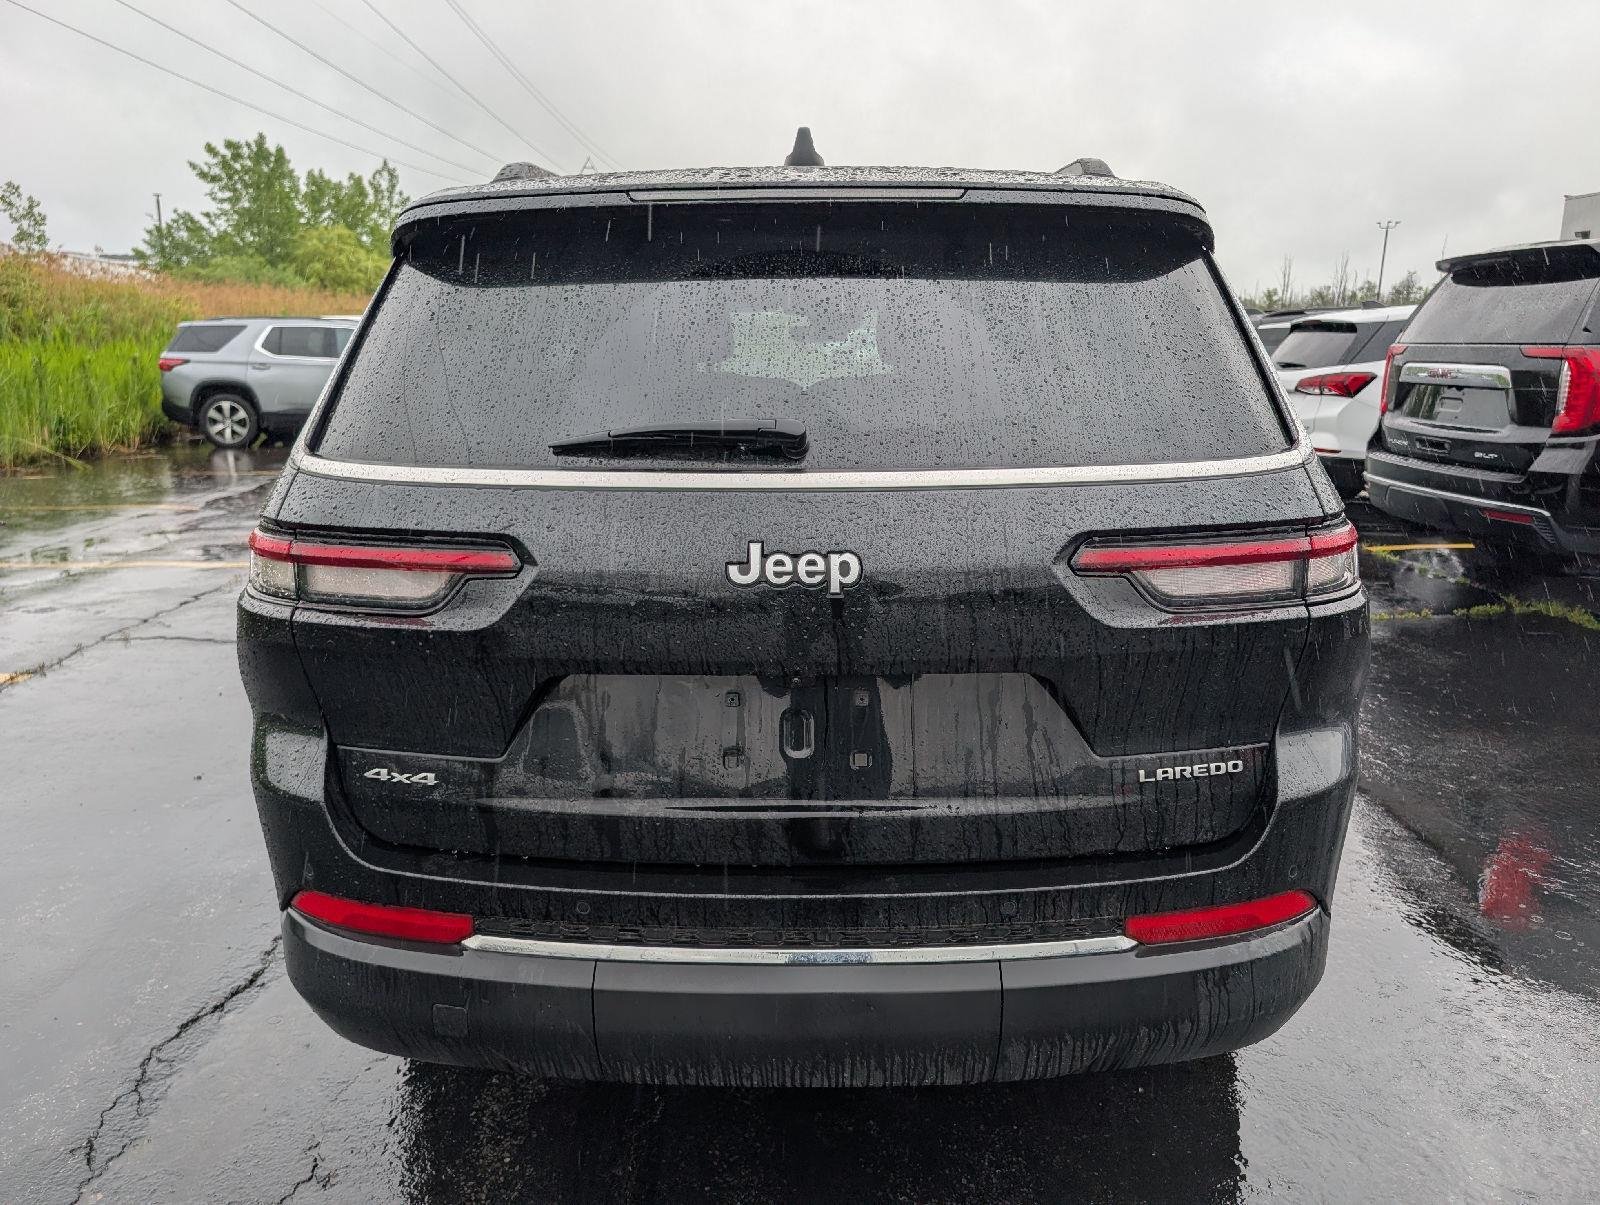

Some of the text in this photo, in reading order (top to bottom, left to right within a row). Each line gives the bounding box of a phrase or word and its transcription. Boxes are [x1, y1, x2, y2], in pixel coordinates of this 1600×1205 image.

[727, 541, 861, 593] Jeep
[363, 767, 439, 786] 4x4
[1138, 759, 1244, 783] LAREDO
